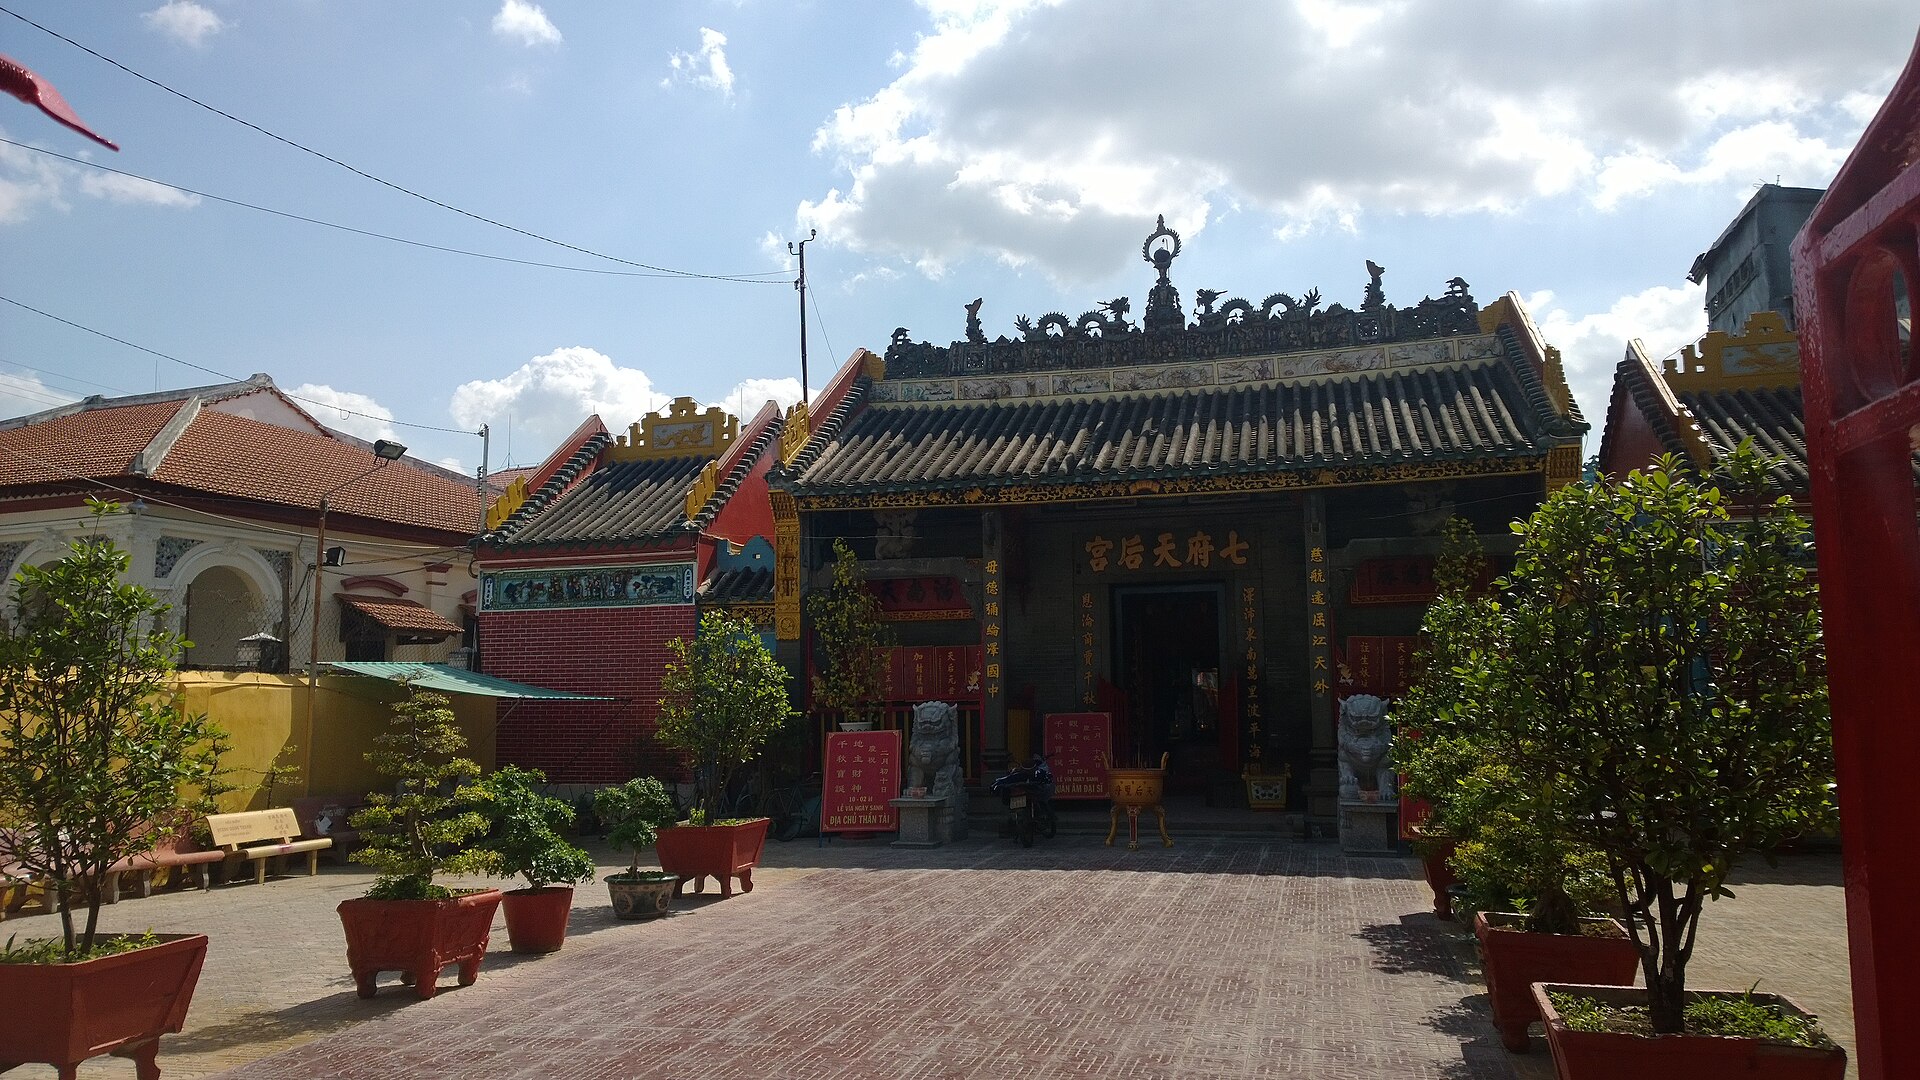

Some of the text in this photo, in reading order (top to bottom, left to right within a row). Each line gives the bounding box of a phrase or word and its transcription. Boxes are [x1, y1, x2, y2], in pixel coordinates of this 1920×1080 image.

[1085, 529, 1250, 572] 七府天后宮
[851, 740, 864, 793] 地主財神
[830, 815, 841, 827] ĐỊA
